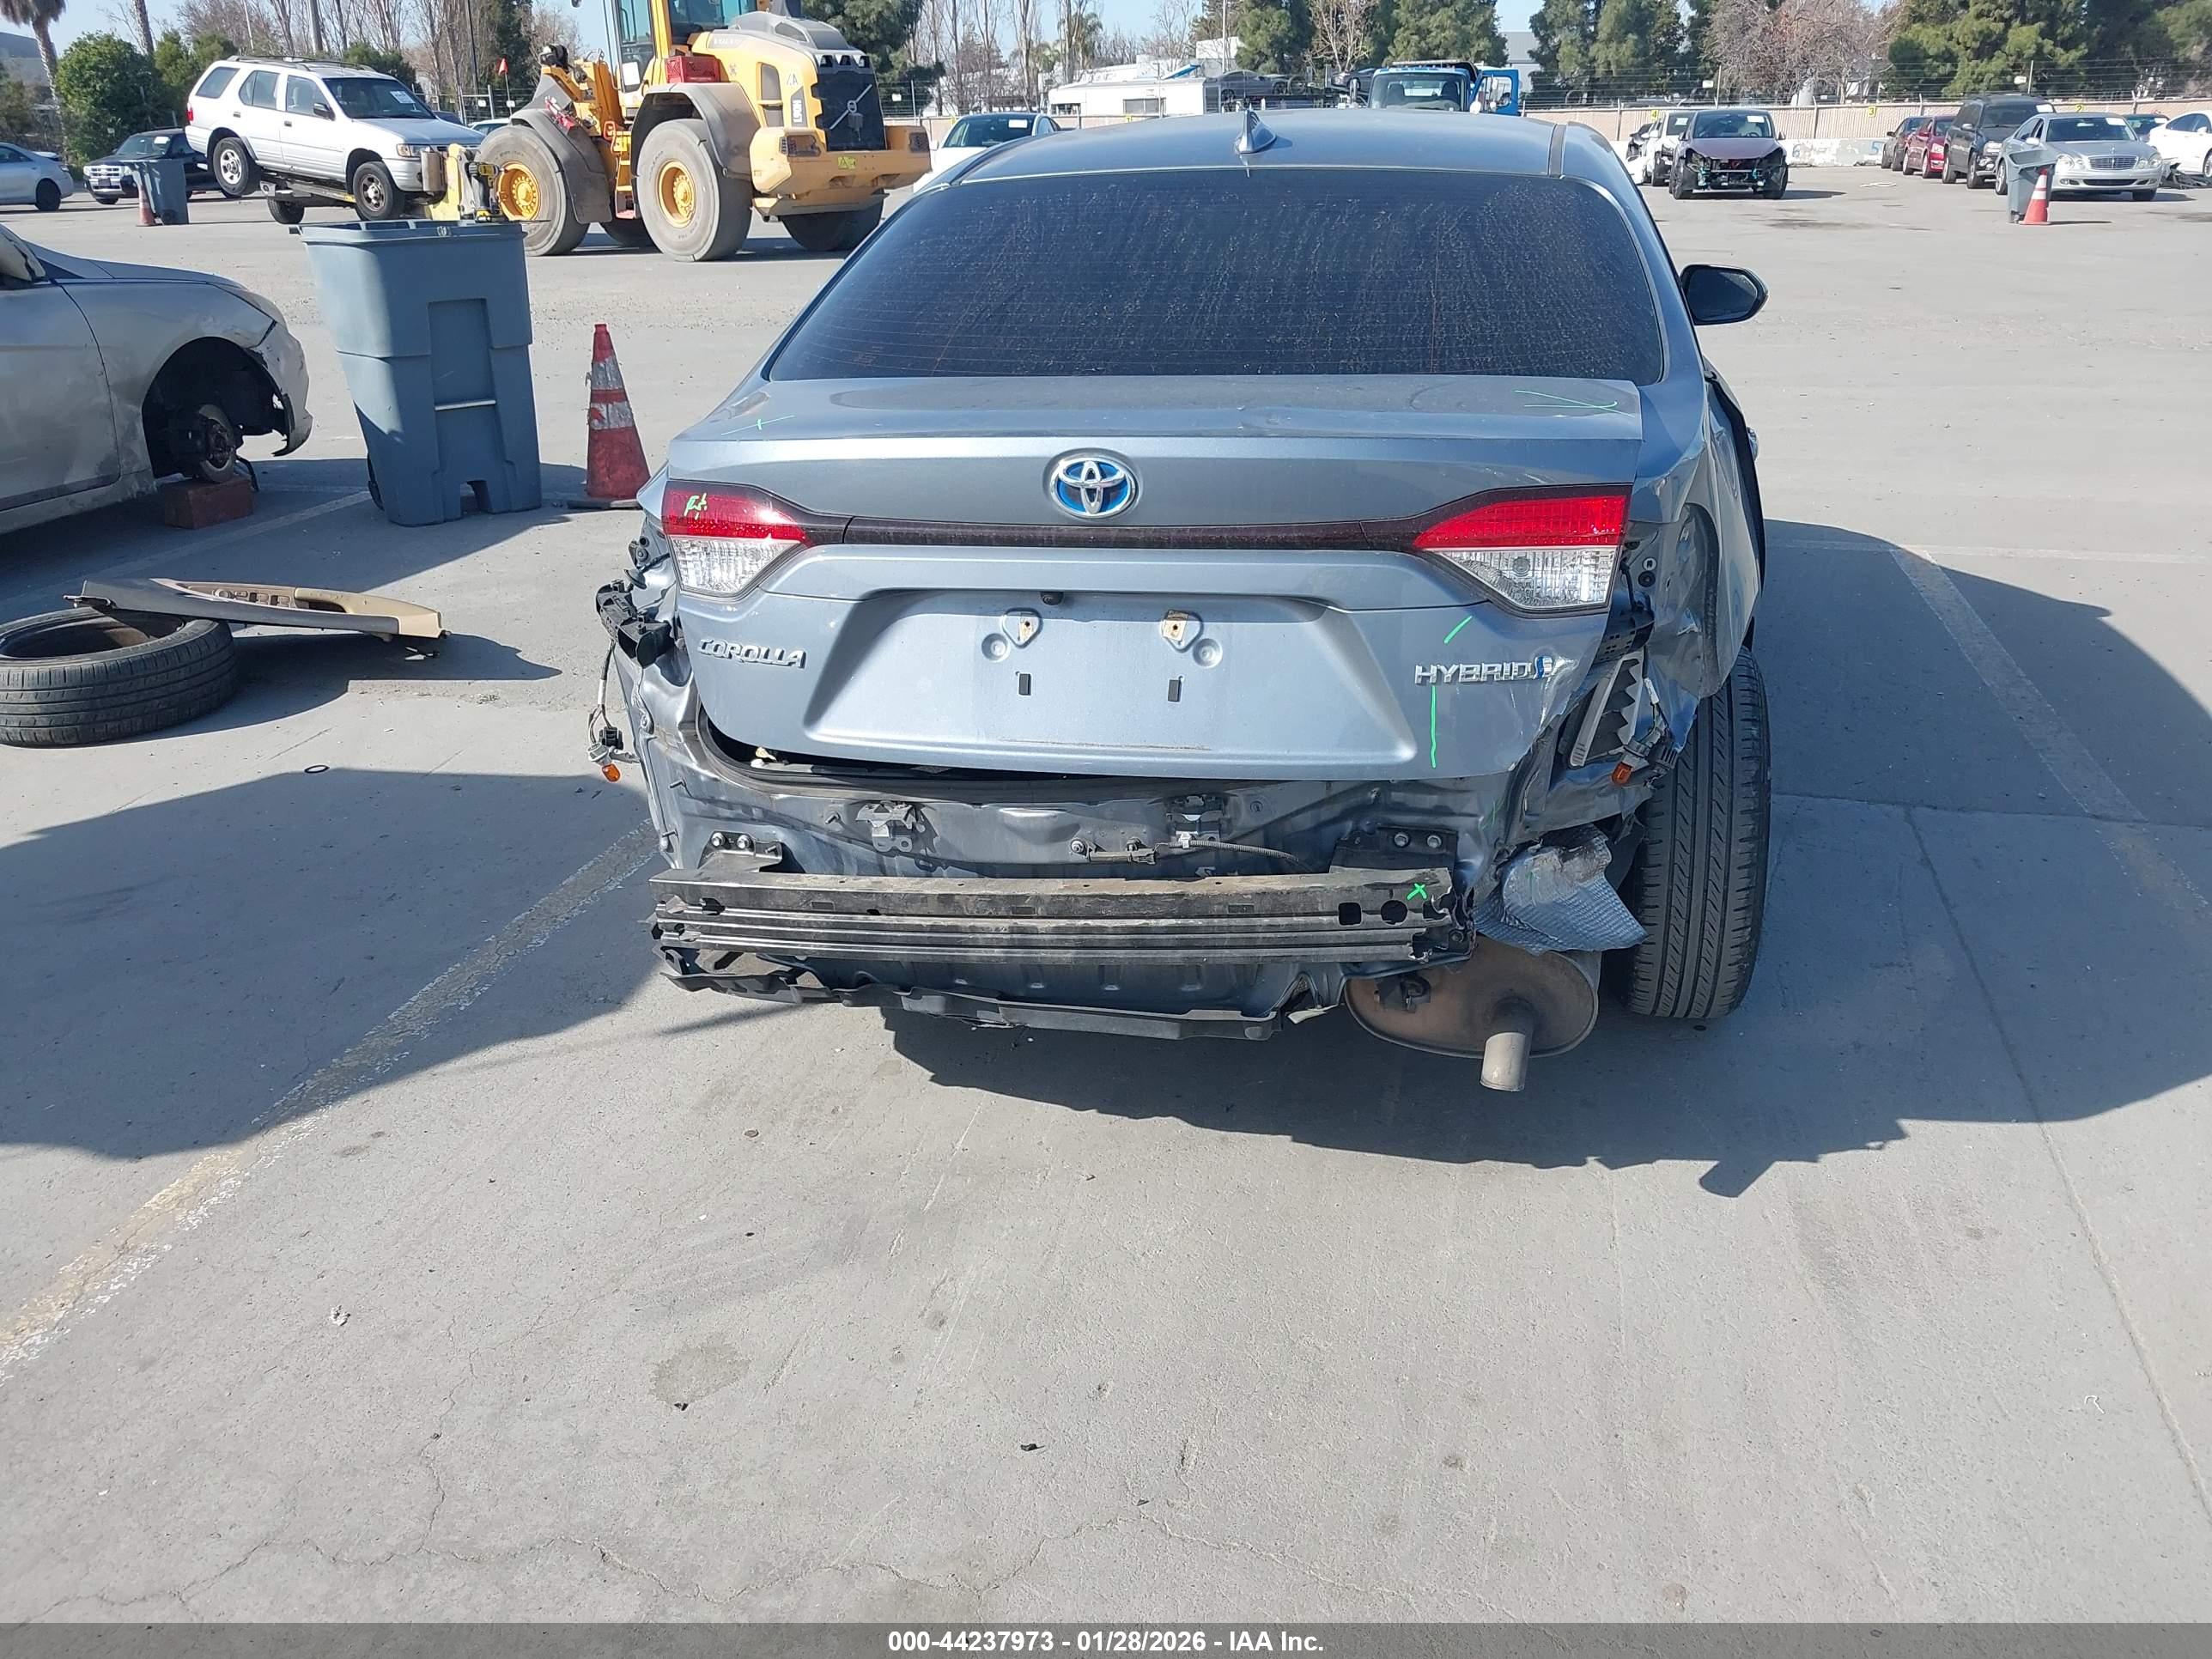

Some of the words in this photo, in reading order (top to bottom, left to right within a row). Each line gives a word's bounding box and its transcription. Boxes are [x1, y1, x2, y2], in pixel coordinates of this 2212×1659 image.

[1868, 140, 1885, 156] 5
[698, 639, 807, 670] COROLLA
[1414, 661, 1533, 684] HYBRID
